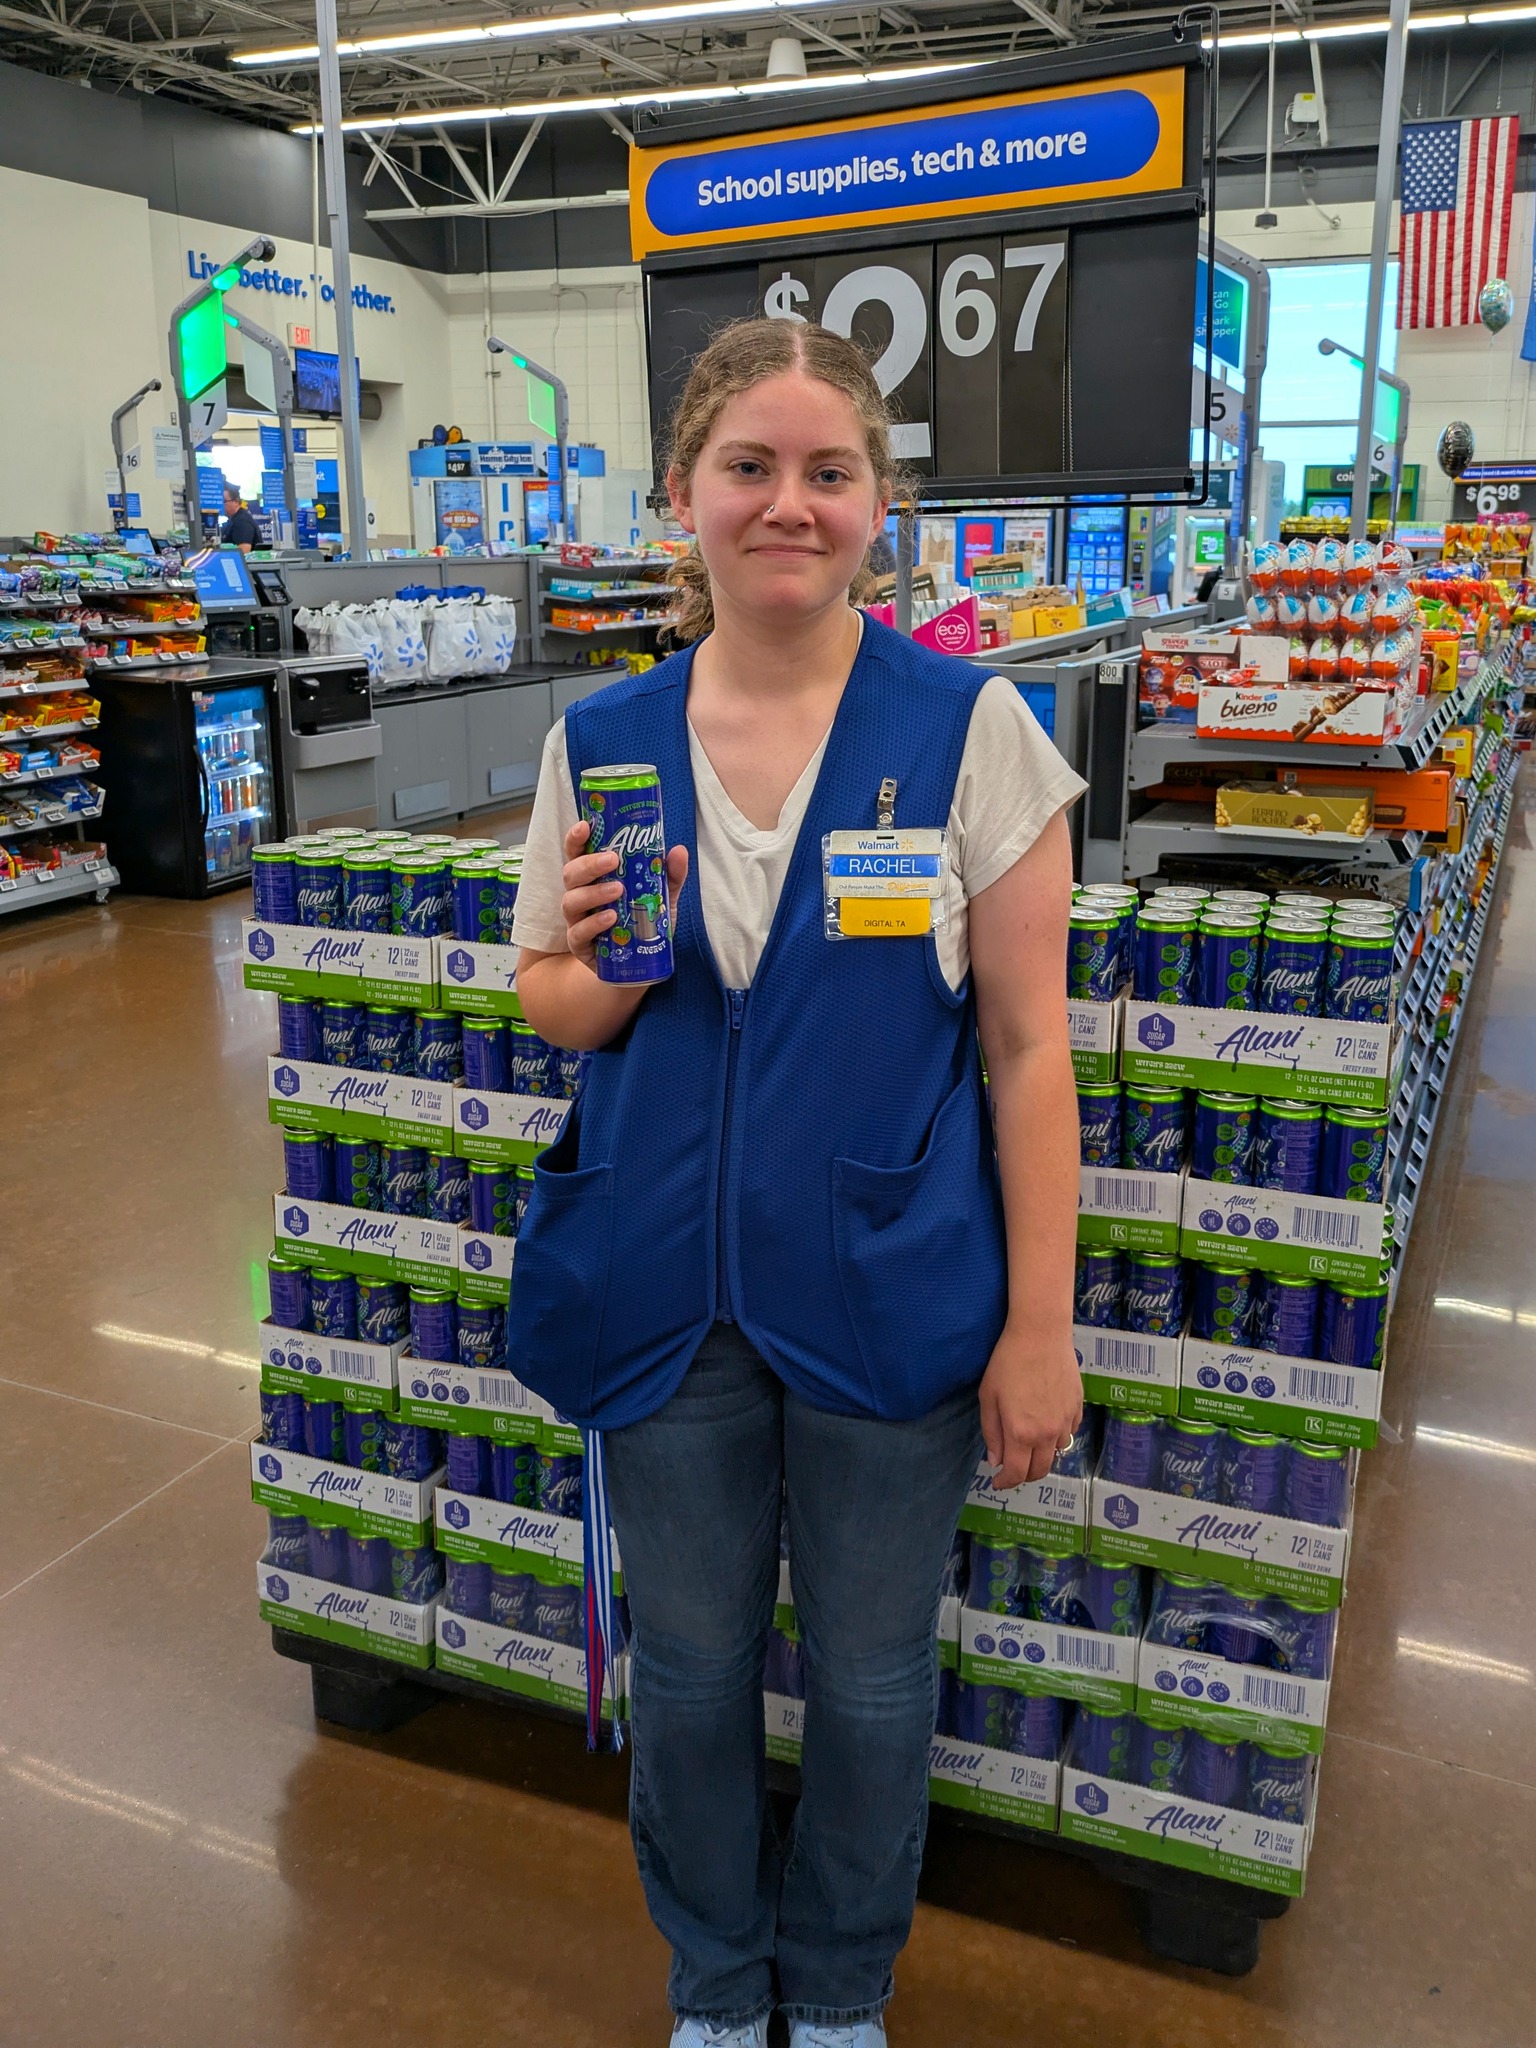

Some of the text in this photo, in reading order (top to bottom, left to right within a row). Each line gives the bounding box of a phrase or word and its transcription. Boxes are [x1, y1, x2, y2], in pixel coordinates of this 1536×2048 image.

[698, 129, 1087, 206] School supplies, tech & more
[239, 267, 308, 298] better.
[294, 327, 311, 345] EXIT
[202, 403, 216, 426] 7
[1209, 392, 1226, 422] 5
[480, 455, 502, 463] Home
[503, 455, 519, 464] City
[1374, 444, 1385, 461] 6
[126, 455, 138, 467] 16
[938, 624, 966, 636] eos
[1100, 665, 1117, 678] 800
[1236, 692, 1262, 700] kinder
[1221, 700, 1277, 718] bueno
[618, 801, 645, 814] WITCH'S
[1251, 808, 1288, 817] FERRERO
[1251, 816, 1287, 826] ROCHER
[858, 841, 899, 850] Walmart
[849, 859, 921, 874] RACHEL
[887, 882, 929, 893] Difference
[255, 944, 268, 952] SUGAR
[637, 940, 666, 955] ENERGY
[303, 937, 365, 978] Alani
[388, 947, 399, 964] 12
[405, 958, 418, 967] CANS
[454, 964, 468, 973] SUGAR
[1262, 967, 1319, 1004] Alani
[1078, 1014, 1085, 1023] 12
[1078, 1025, 1095, 1035] CANS
[1147, 1032, 1165, 1041] SUGAR
[1082, 1040, 1096, 1048] DRINK
[1214, 1024, 1304, 1073] Alani
[1335, 1037, 1352, 1057] 12
[1359, 1039, 1366, 1048] 12
[1358, 1050, 1377, 1060] CANS
[1342, 1064, 1361, 1073] ENERGY
[1319, 1076, 1332, 1084] CANS
[1334, 1078, 1346, 1086] (NET
[1348, 1079, 1357, 1087] 144
[1366, 1081, 1375, 1090] OZ)
[328, 1077, 389, 1115] Alani
[412, 1089, 423, 1106] 12
[1328, 1089, 1341, 1097] CANS
[1343, 1090, 1355, 1098] (NET
[1356, 1091, 1374, 1101] 4.26L)
[427, 1101, 441, 1110] CANS
[467, 1112, 482, 1121] SUGAR
[1224, 1195, 1258, 1213] Alani
[336, 1218, 398, 1256] Alani
[420, 1231, 432, 1248] 12
[436, 1243, 450, 1251] CANS
[1330, 1268, 1349, 1276] CAFFEINE
[1221, 1353, 1254, 1371] Alani
[307, 1471, 363, 1505] Alani
[384, 1487, 395, 1503] 12
[1038, 1486, 1053, 1505] 12
[1058, 1499, 1074, 1510] CANS
[1112, 1510, 1130, 1520] SUGAR
[498, 1517, 559, 1553] Alani
[1176, 1514, 1262, 1557] Alani
[1291, 1536, 1307, 1555] 12
[1313, 1550, 1331, 1561] CANS
[314, 1592, 369, 1626] Alani
[389, 1610, 400, 1626] 12
[995, 1622, 1024, 1640] Alani
[493, 1639, 554, 1674] Alani
[1178, 1658, 1209, 1676] Alani
[782, 1710, 794, 1726] 12
[1011, 1766, 1025, 1785] 12
[1030, 1779, 1046, 1790] CANS
[1082, 1797, 1100, 1809] SUGAR
[1144, 1805, 1226, 1844] Alani
[1254, 1829, 1269, 1848] 12
[1275, 1843, 1293, 1854] CANS
